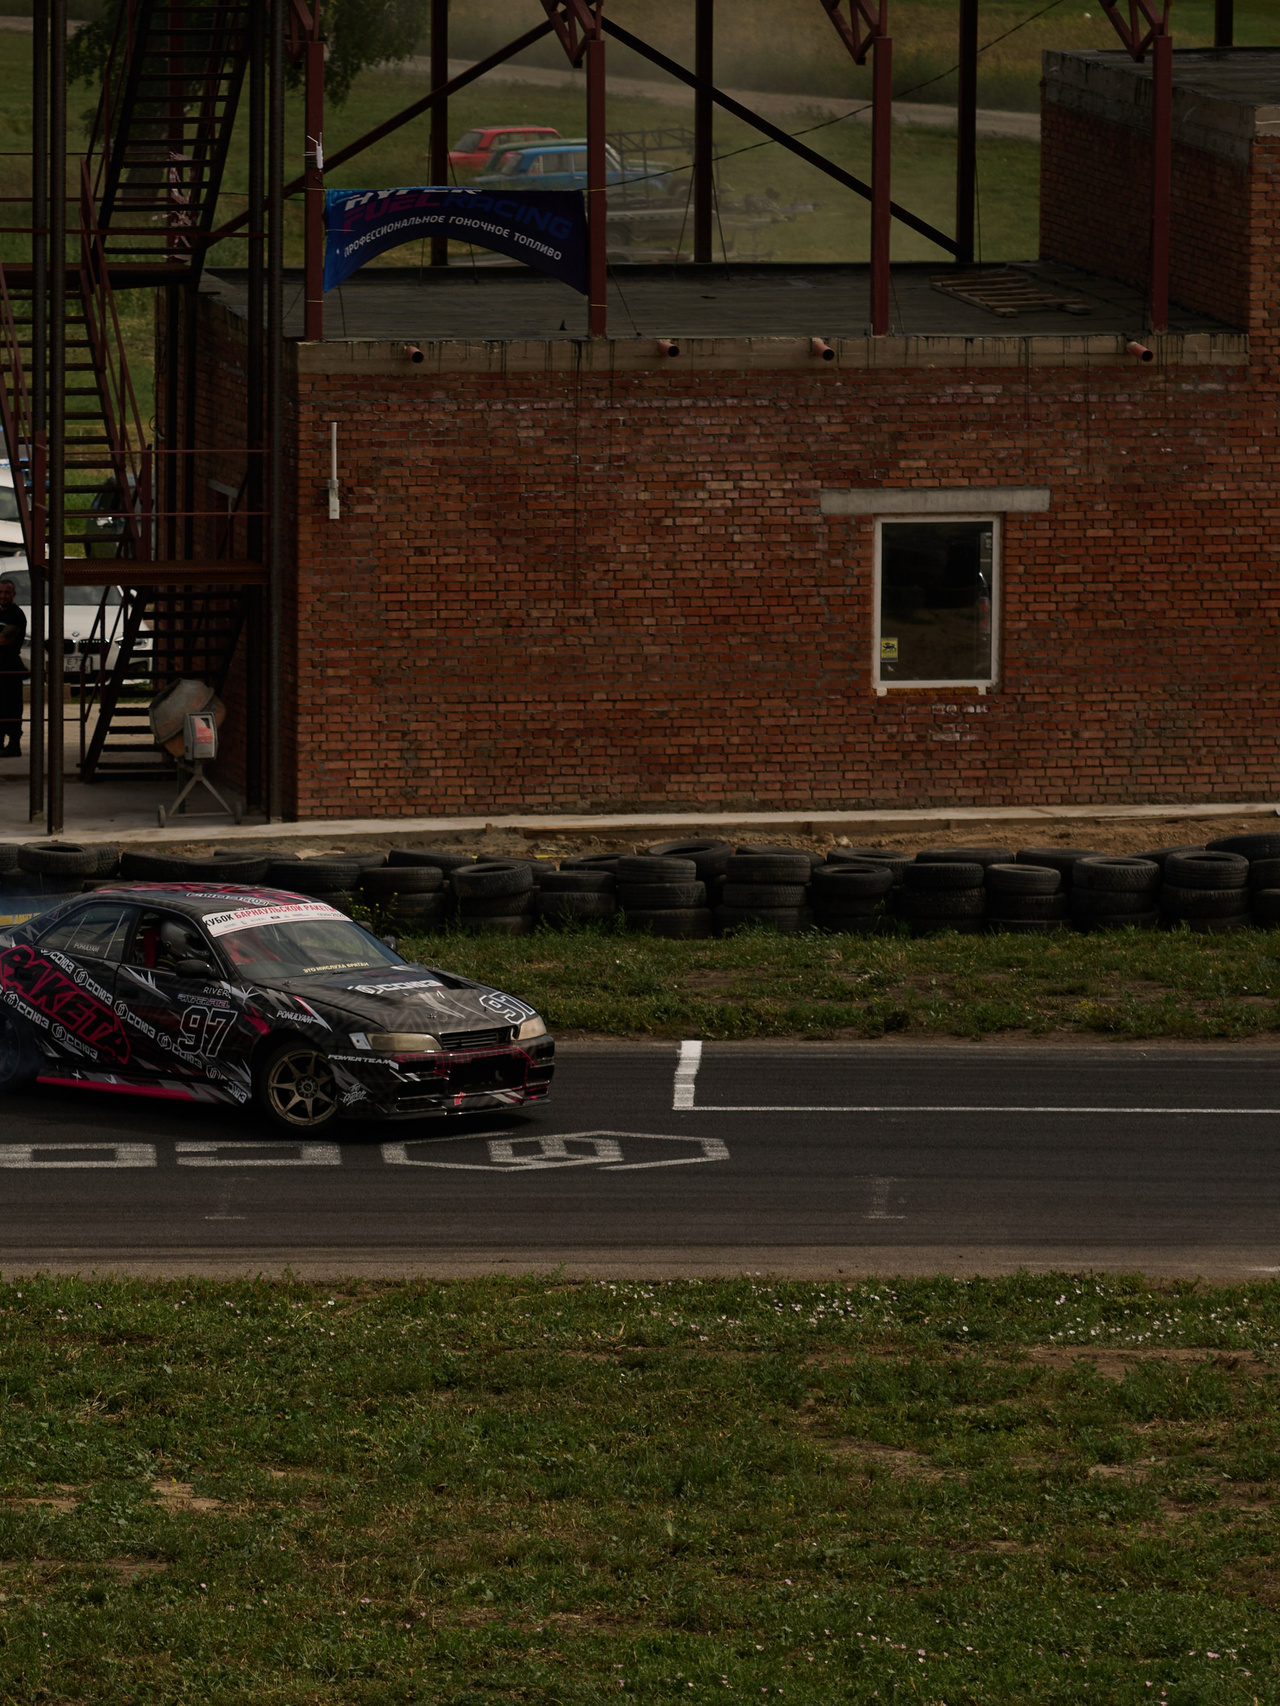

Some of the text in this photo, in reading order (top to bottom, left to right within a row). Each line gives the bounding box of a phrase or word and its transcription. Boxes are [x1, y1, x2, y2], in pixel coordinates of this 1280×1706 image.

[343, 193, 574, 240] FUEL RACING
[344, 215, 563, 261] ПРОФЕССИОНАЛЬНОЕ ГОНОЧНОЕ ТОПЛИВО
[205, 914, 234, 927] КУБОК
[234, 906, 303, 919] БАРНАУЛЬСКОЙ
[51, 951, 75, 974] СОЮЗ
[85, 979, 114, 1005] СОЮЗ
[203, 986, 231, 997] RIVER
[381, 979, 444, 991] СОЮЗ
[16, 1001, 50, 1030] СОЮЗ
[479, 991, 536, 1024] 97
[126, 1012, 155, 1040] СОЮЗ
[177, 1005, 238, 1057] 97
[65, 1035, 99, 1060] СОЮЗ
[328, 1053, 392, 1065] POWERTEAM
